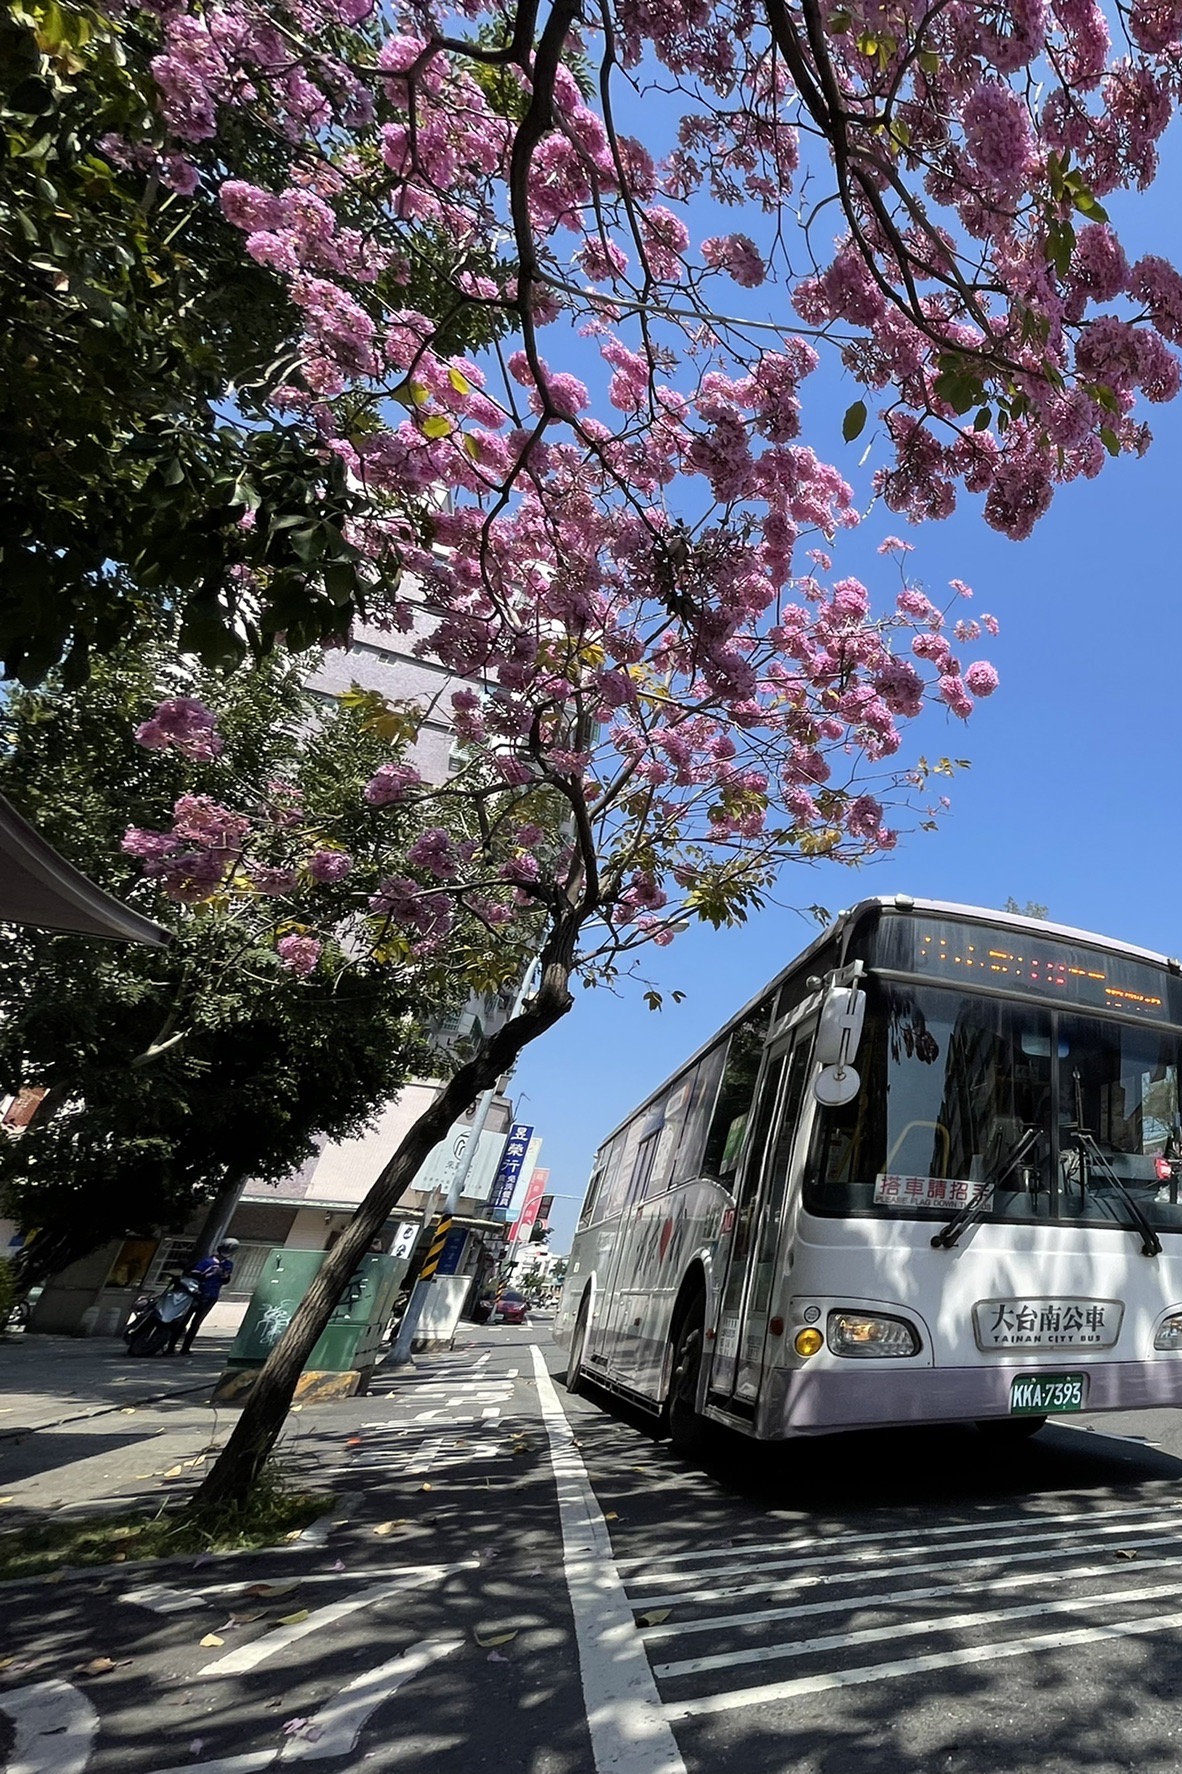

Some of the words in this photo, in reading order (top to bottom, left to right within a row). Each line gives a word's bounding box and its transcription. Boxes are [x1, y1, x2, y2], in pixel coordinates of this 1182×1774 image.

[501, 1126, 528, 1173] 昱榮行
[910, 1198, 931, 1207] FLAG
[933, 1200, 957, 1208] DOWN
[990, 1304, 1106, 1332] 大台南公車
[994, 1335, 1042, 1343] TAINAN
[1048, 1334, 1074, 1343] CITY
